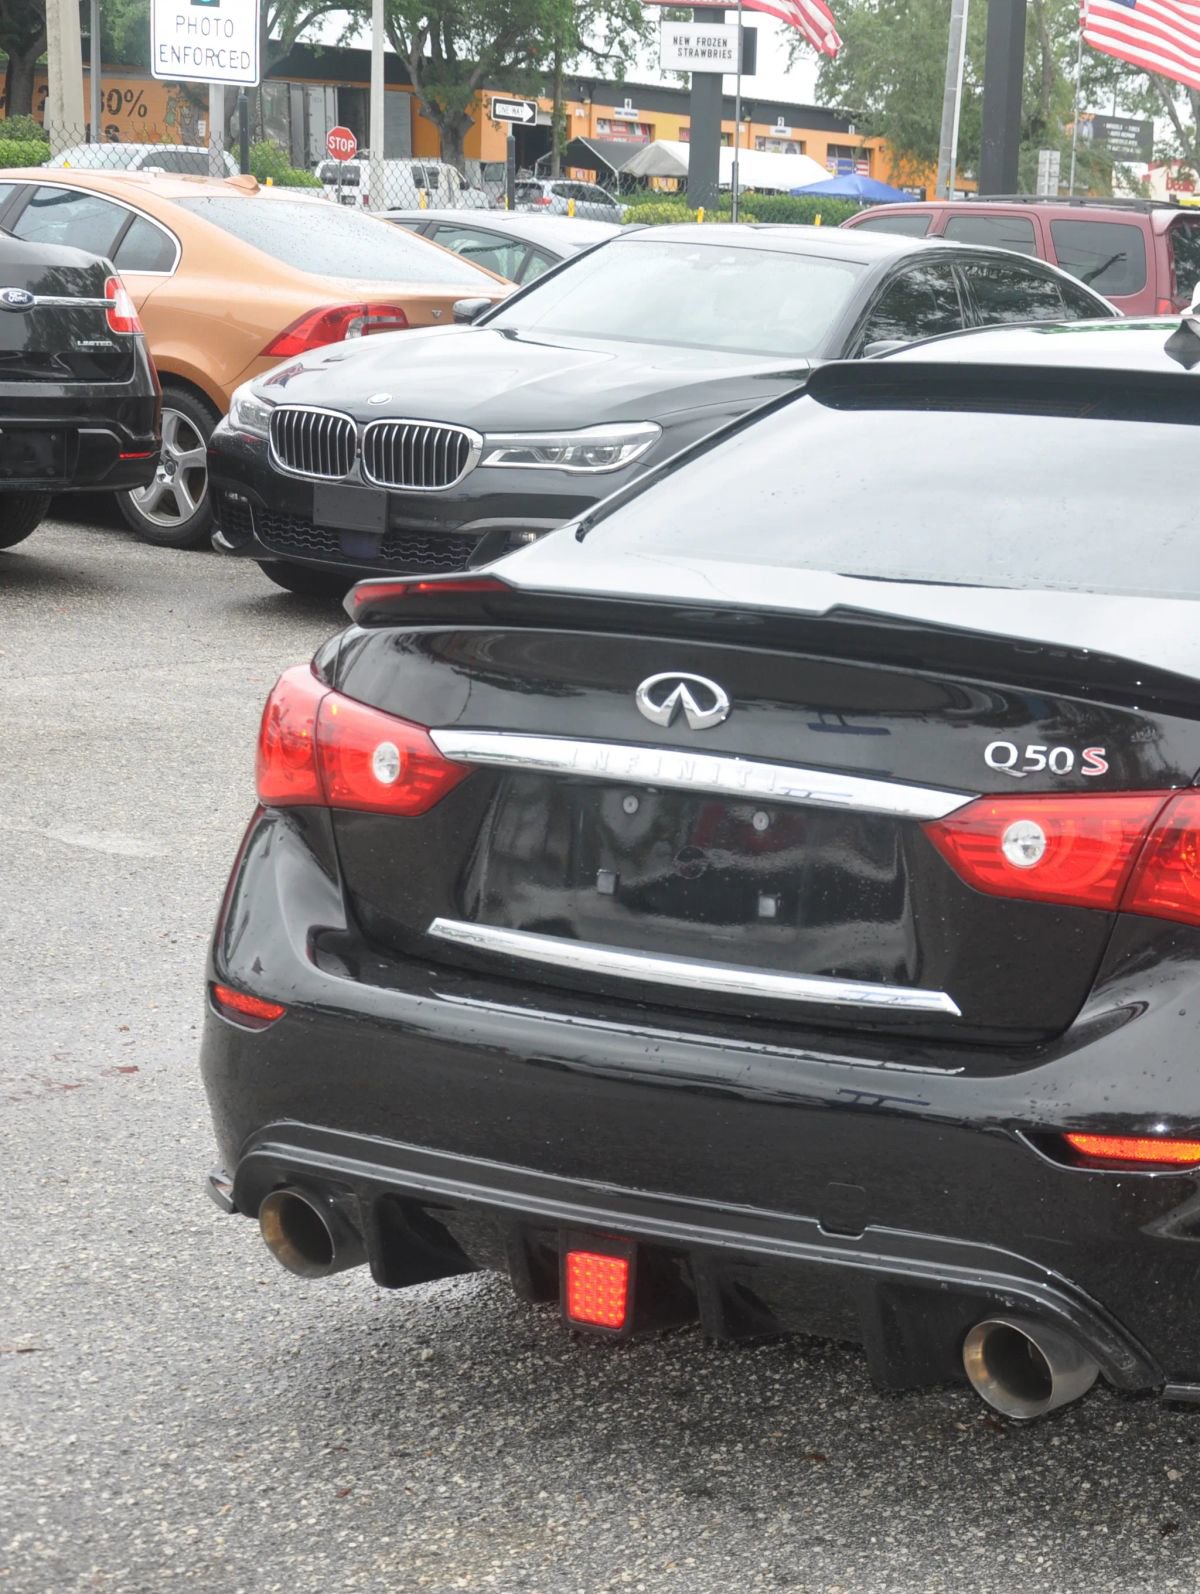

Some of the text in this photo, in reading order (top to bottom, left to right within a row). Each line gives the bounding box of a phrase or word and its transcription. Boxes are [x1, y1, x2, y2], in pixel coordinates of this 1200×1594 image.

[175, 15, 234, 38] PHOTO
[673, 36, 728, 47] NEW FROZEN
[159, 44, 250, 70] ENFORCED
[677, 47, 732, 59] STRAWBRIES
[328, 135, 355, 153] STOP
[8, 291, 29, 303] Ford
[570, 747, 778, 792] INFINITI
